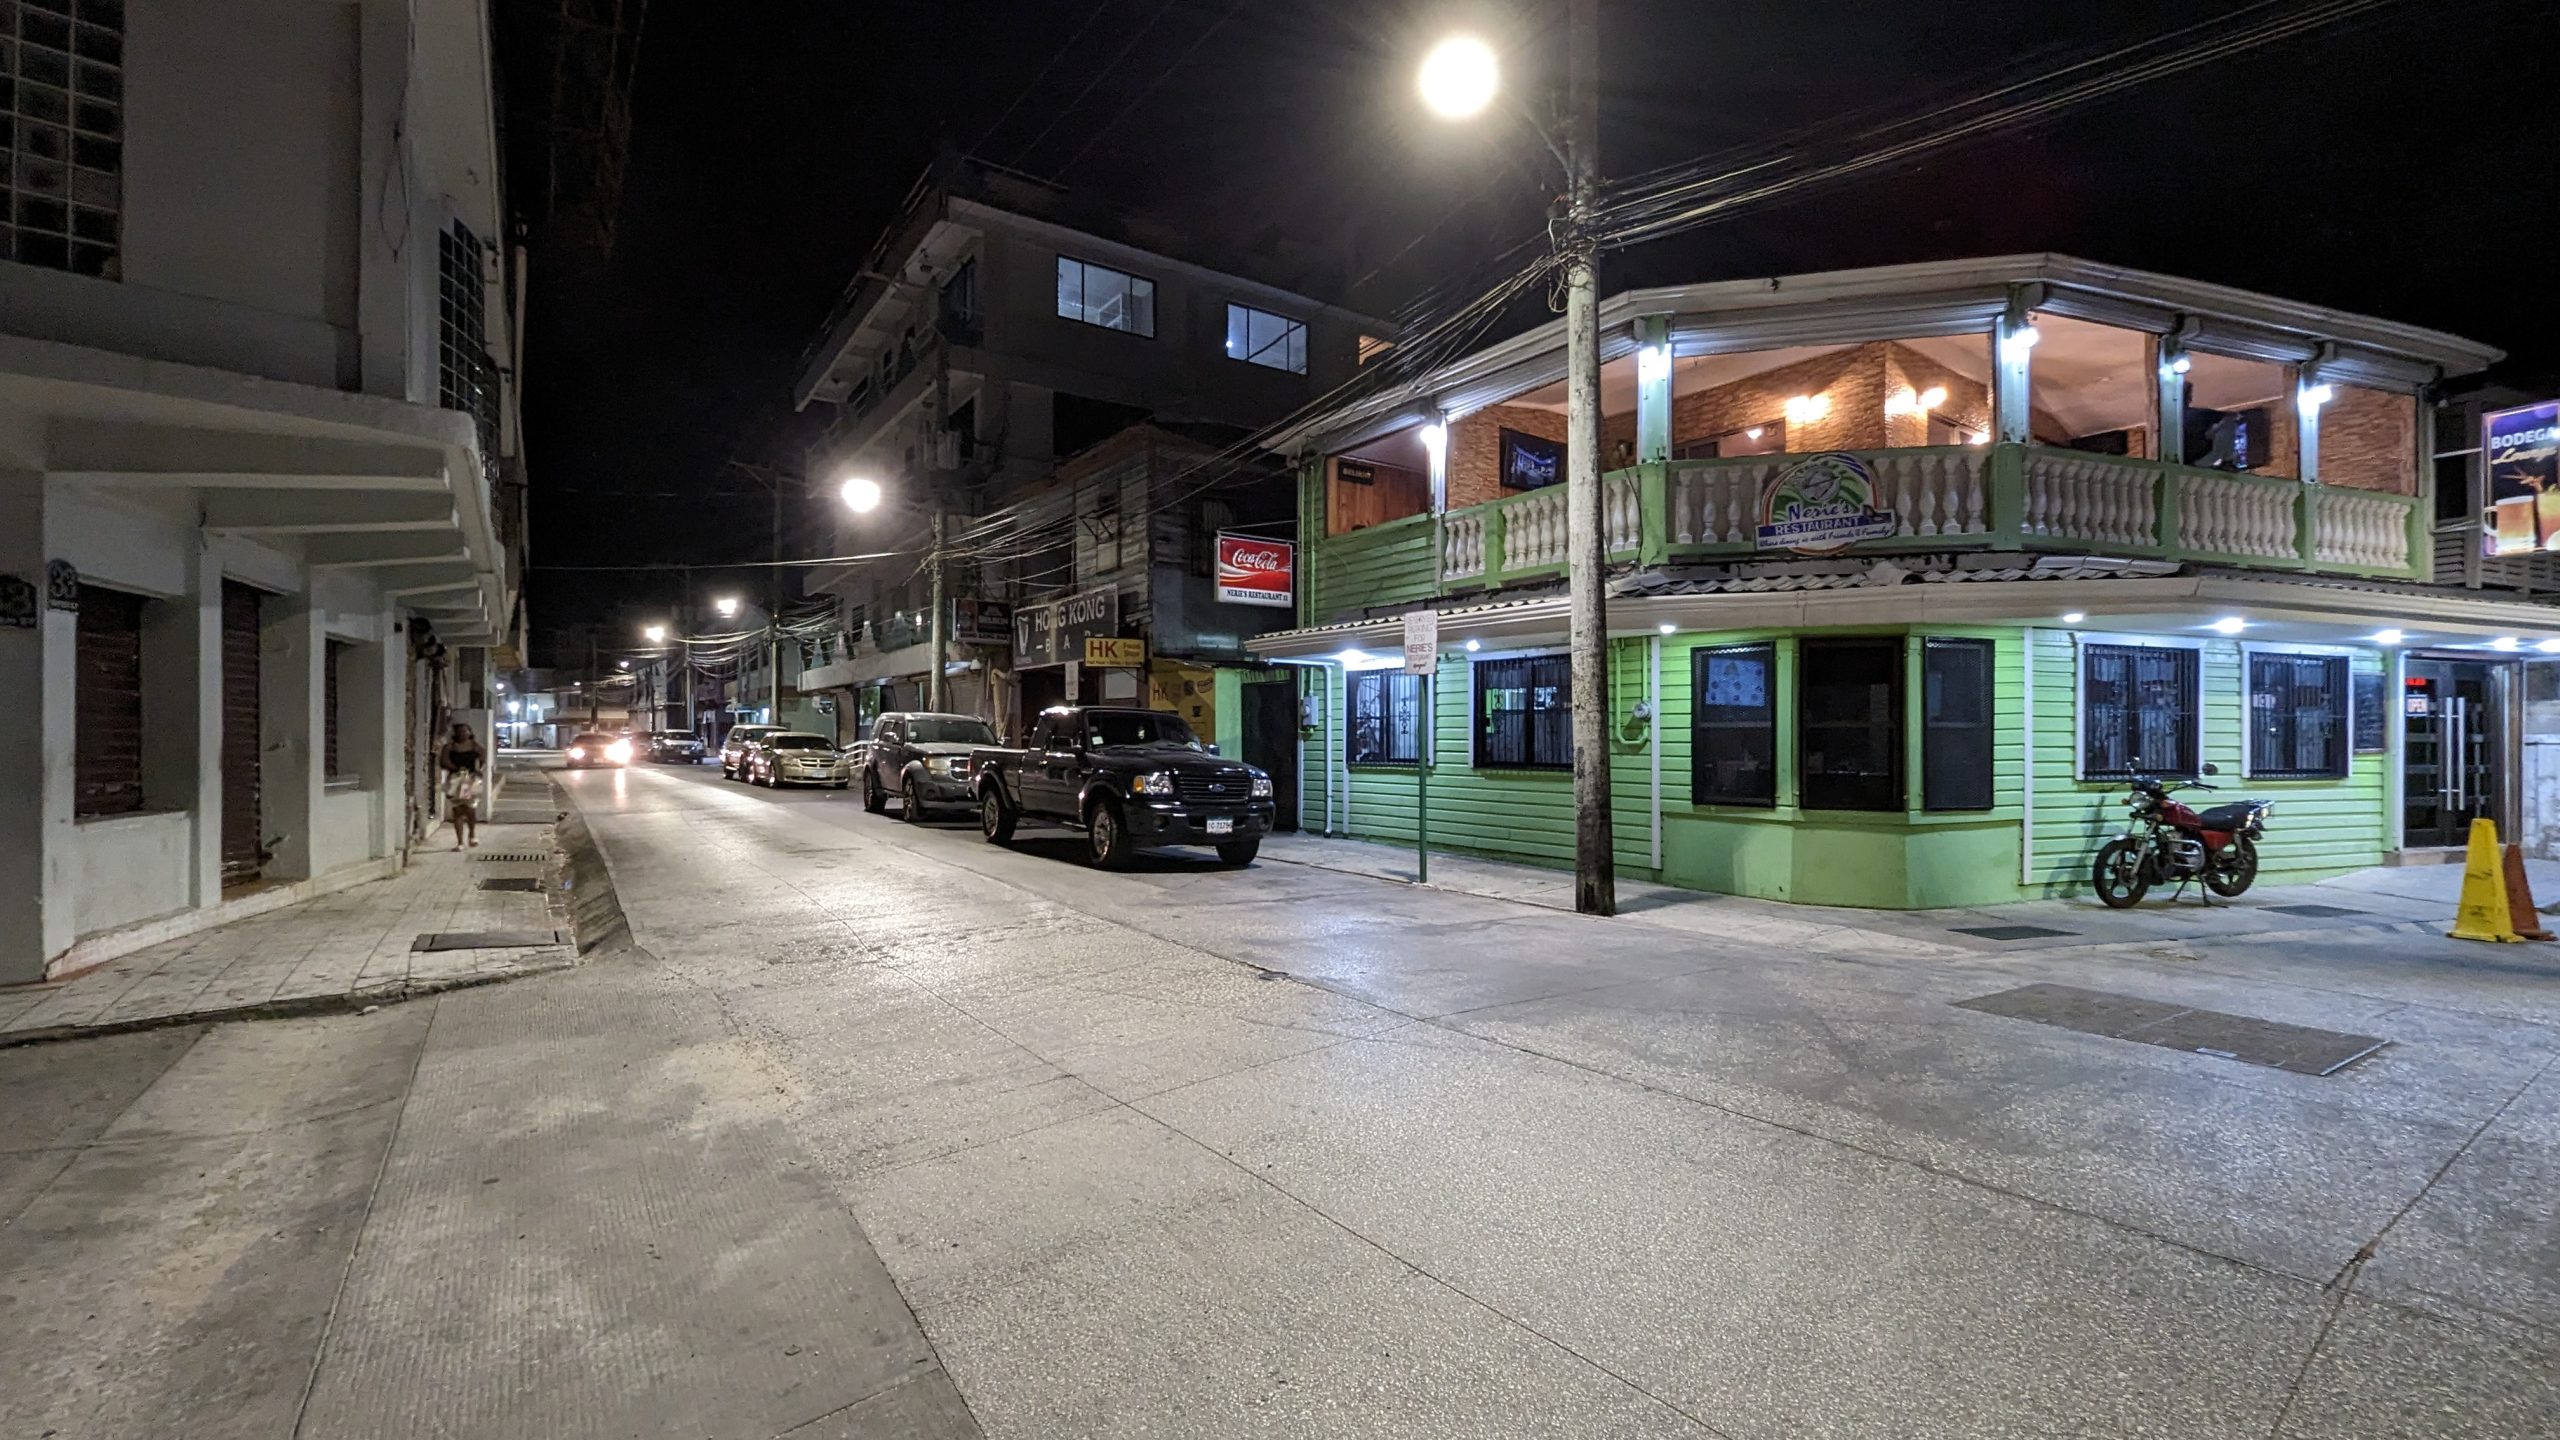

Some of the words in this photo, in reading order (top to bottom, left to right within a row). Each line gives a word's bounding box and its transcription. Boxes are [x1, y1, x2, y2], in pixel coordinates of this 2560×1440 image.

[1788, 500, 1852, 521] Nerie's
[1775, 516, 1859, 535] RESTAURANT
[1248, 590, 1283, 601] RESTAURANT
[1035, 606, 1066, 632] HOG
[1069, 596, 1105, 625] KONG
[1090, 640, 1118, 658] HK
